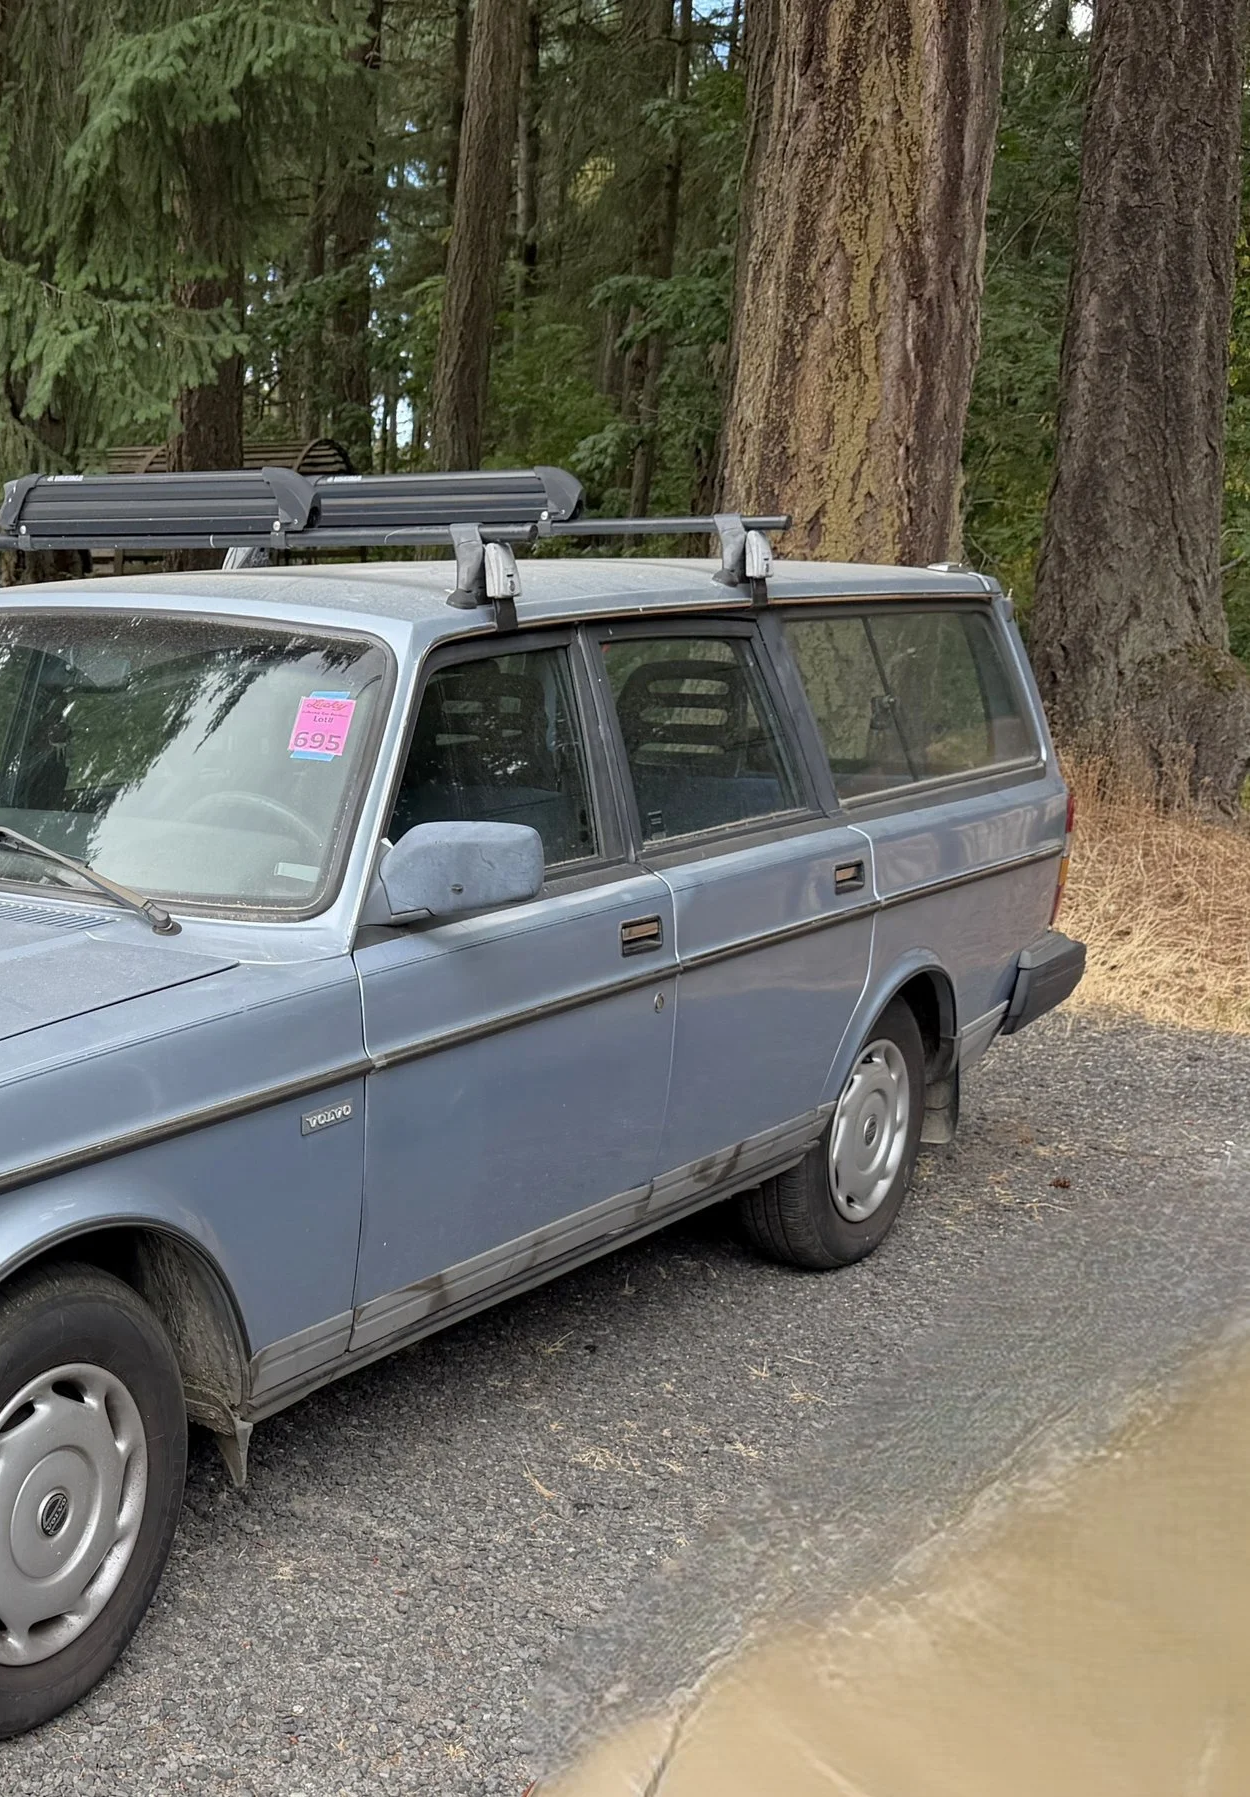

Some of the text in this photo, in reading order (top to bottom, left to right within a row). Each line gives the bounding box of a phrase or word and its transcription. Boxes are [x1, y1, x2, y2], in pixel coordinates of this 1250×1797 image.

[306, 699, 349, 712] Lucky
[293, 731, 342, 752] 695
[305, 1104, 352, 1128] VOLVO
